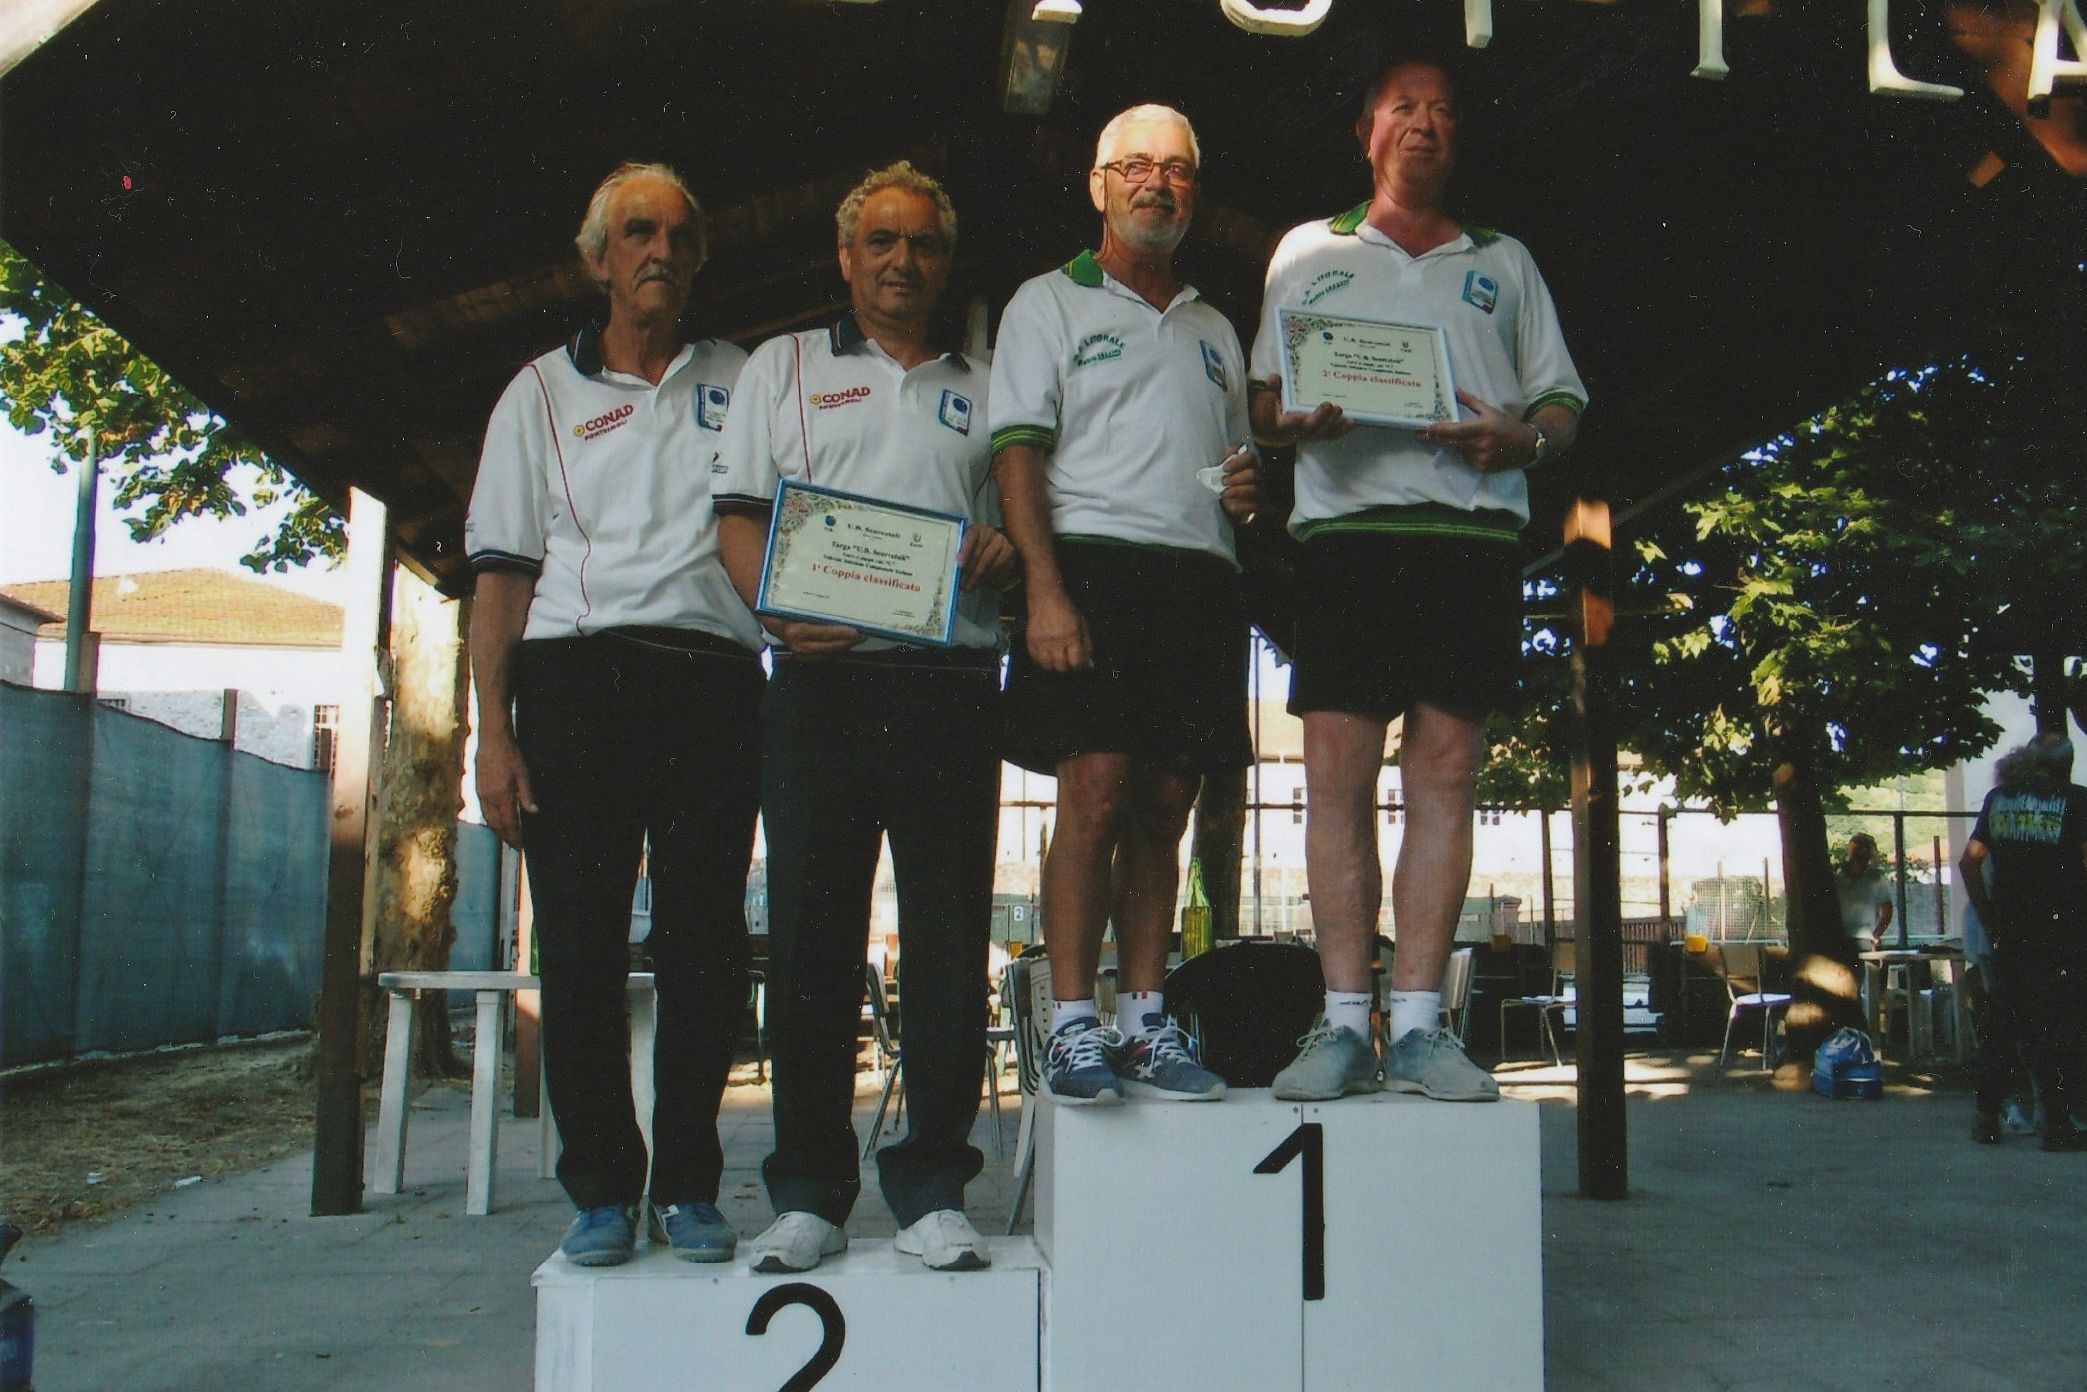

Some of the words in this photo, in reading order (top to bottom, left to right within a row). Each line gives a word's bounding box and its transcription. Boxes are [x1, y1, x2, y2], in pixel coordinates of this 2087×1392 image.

[1333, 371, 1368, 383] Coppia
[1370, 376, 1421, 387] classificata
[822, 386, 871, 403] CONAD
[585, 404, 634, 431] CONAD
[823, 565, 861, 581] Coppia
[864, 573, 921, 592] classificata
[1252, 1122, 1324, 1301] 1
[745, 1282, 846, 1392] 2
